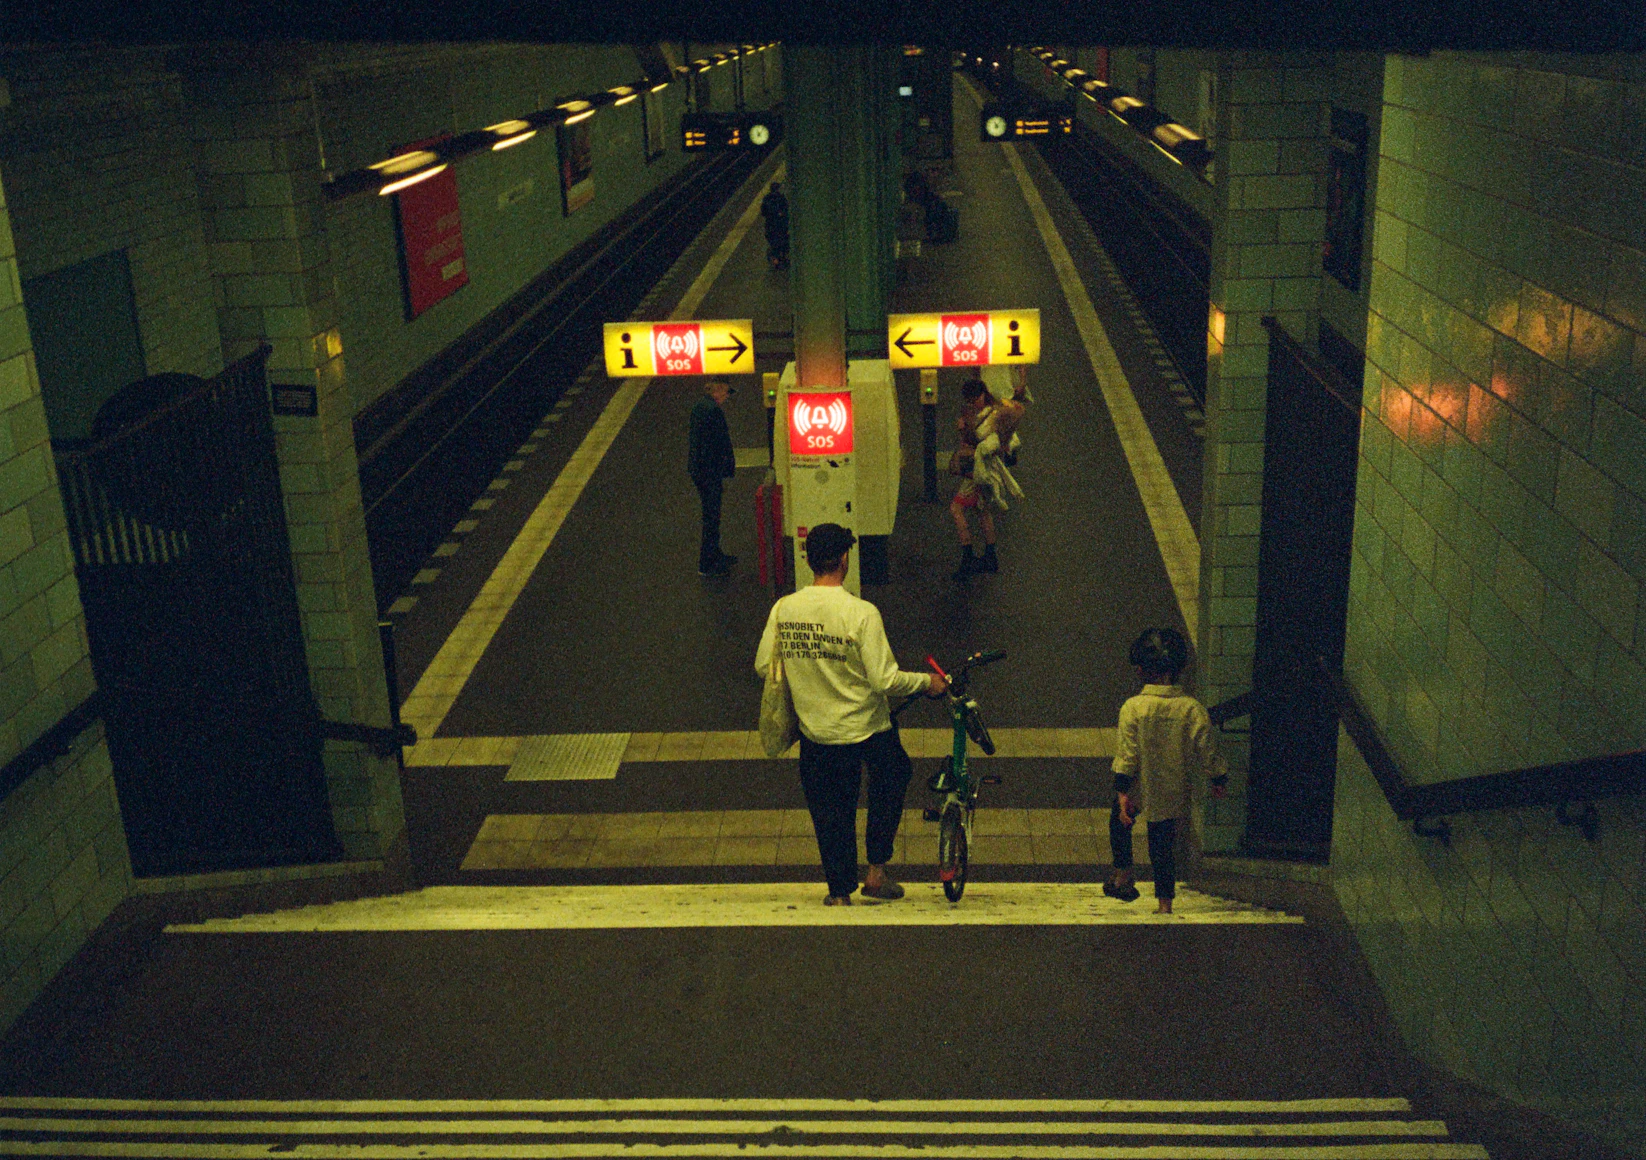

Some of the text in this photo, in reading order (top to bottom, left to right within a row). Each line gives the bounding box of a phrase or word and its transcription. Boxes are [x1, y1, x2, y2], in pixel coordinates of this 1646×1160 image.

[953, 350, 978, 362] SOS
[666, 359, 691, 371] SOS
[807, 435, 834, 448] SOS
[793, 632, 810, 641] DEN
[813, 632, 843, 645] LINDEN
[790, 642, 821, 651] BERLIN
